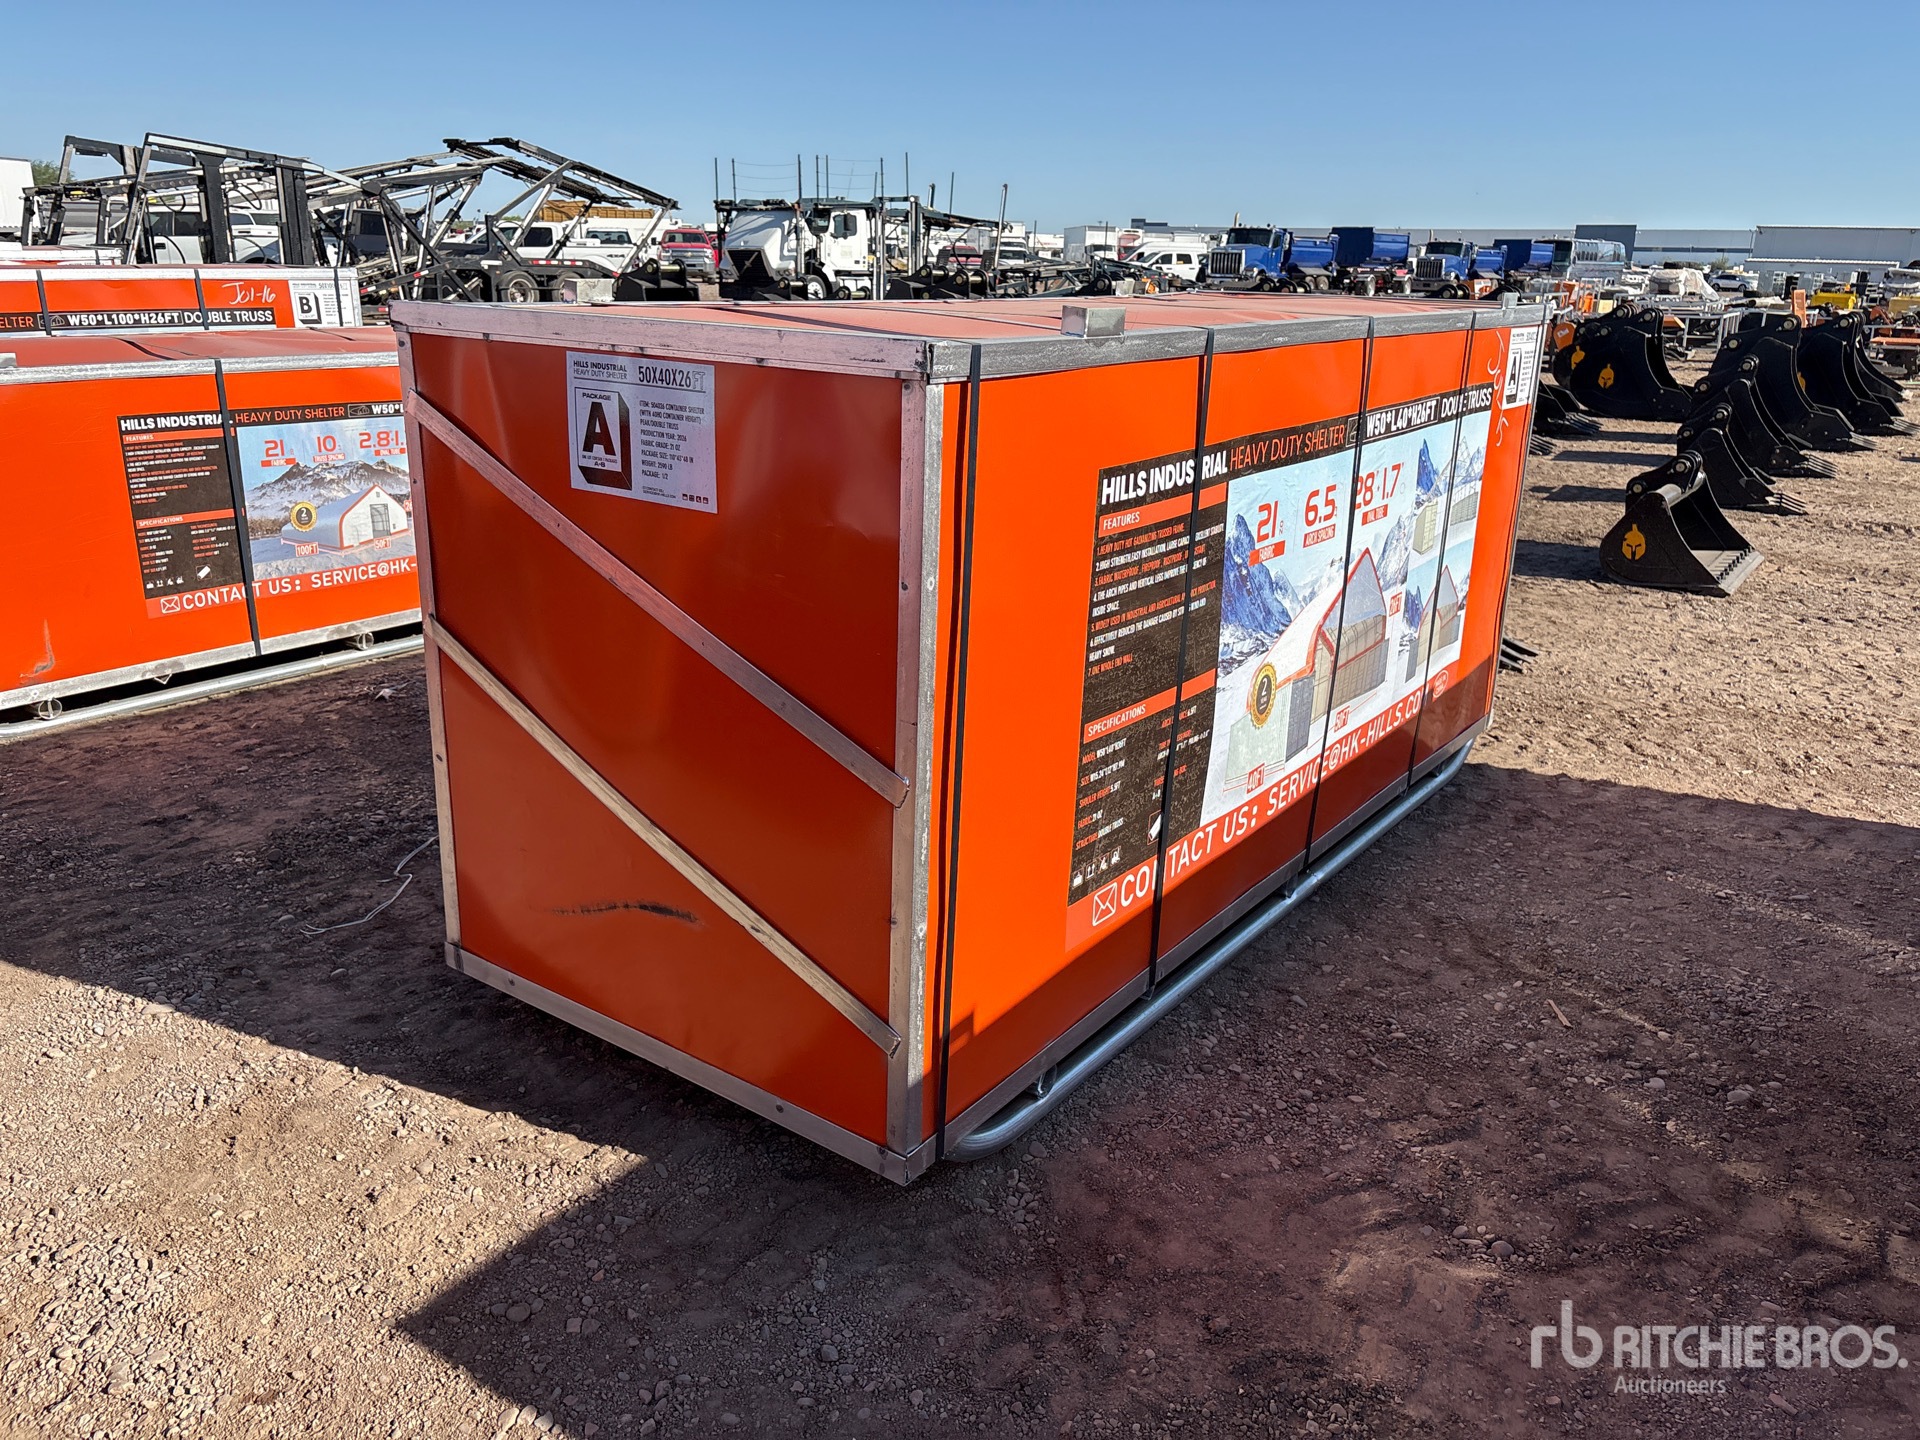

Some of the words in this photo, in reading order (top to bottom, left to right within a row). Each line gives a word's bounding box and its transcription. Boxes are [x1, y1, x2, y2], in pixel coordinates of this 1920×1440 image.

[298, 296, 312, 314] B
[234, 310, 273, 322] TRUSS
[573, 360, 588, 368] HILLS
[590, 362, 627, 372] INDUSTRIAL
[573, 368, 590, 376] HEAVY
[591, 370, 605, 378] DUTY
[1508, 356, 1516, 386] A
[582, 392, 611, 401] PACKAGE
[120, 418, 155, 431] HILLS
[157, 414, 233, 429] INDUSTRIA
[236, 411, 272, 424] HEAVY
[274, 408, 304, 422] DUTY
[304, 406, 345, 420] SHELTER
[582, 402, 616, 456] A
[264, 439, 284, 458] 21
[317, 435, 337, 453] 10
[1102, 470, 1147, 505] HILLS
[1149, 451, 1228, 494] INDUSRIAL
[1230, 441, 1269, 471] HEAVY
[1270, 434, 1303, 461] DUTY
[1304, 424, 1345, 453] SHELTER
[1468, 387, 1492, 410] TRUSS
[1304, 484, 1337, 527] 6.5
[1103, 511, 1140, 531] FEATURES
[1257, 500, 1278, 543] 21
[297, 544, 318, 555] 100FT
[1088, 704, 1146, 736] SPECIFICATIONS
